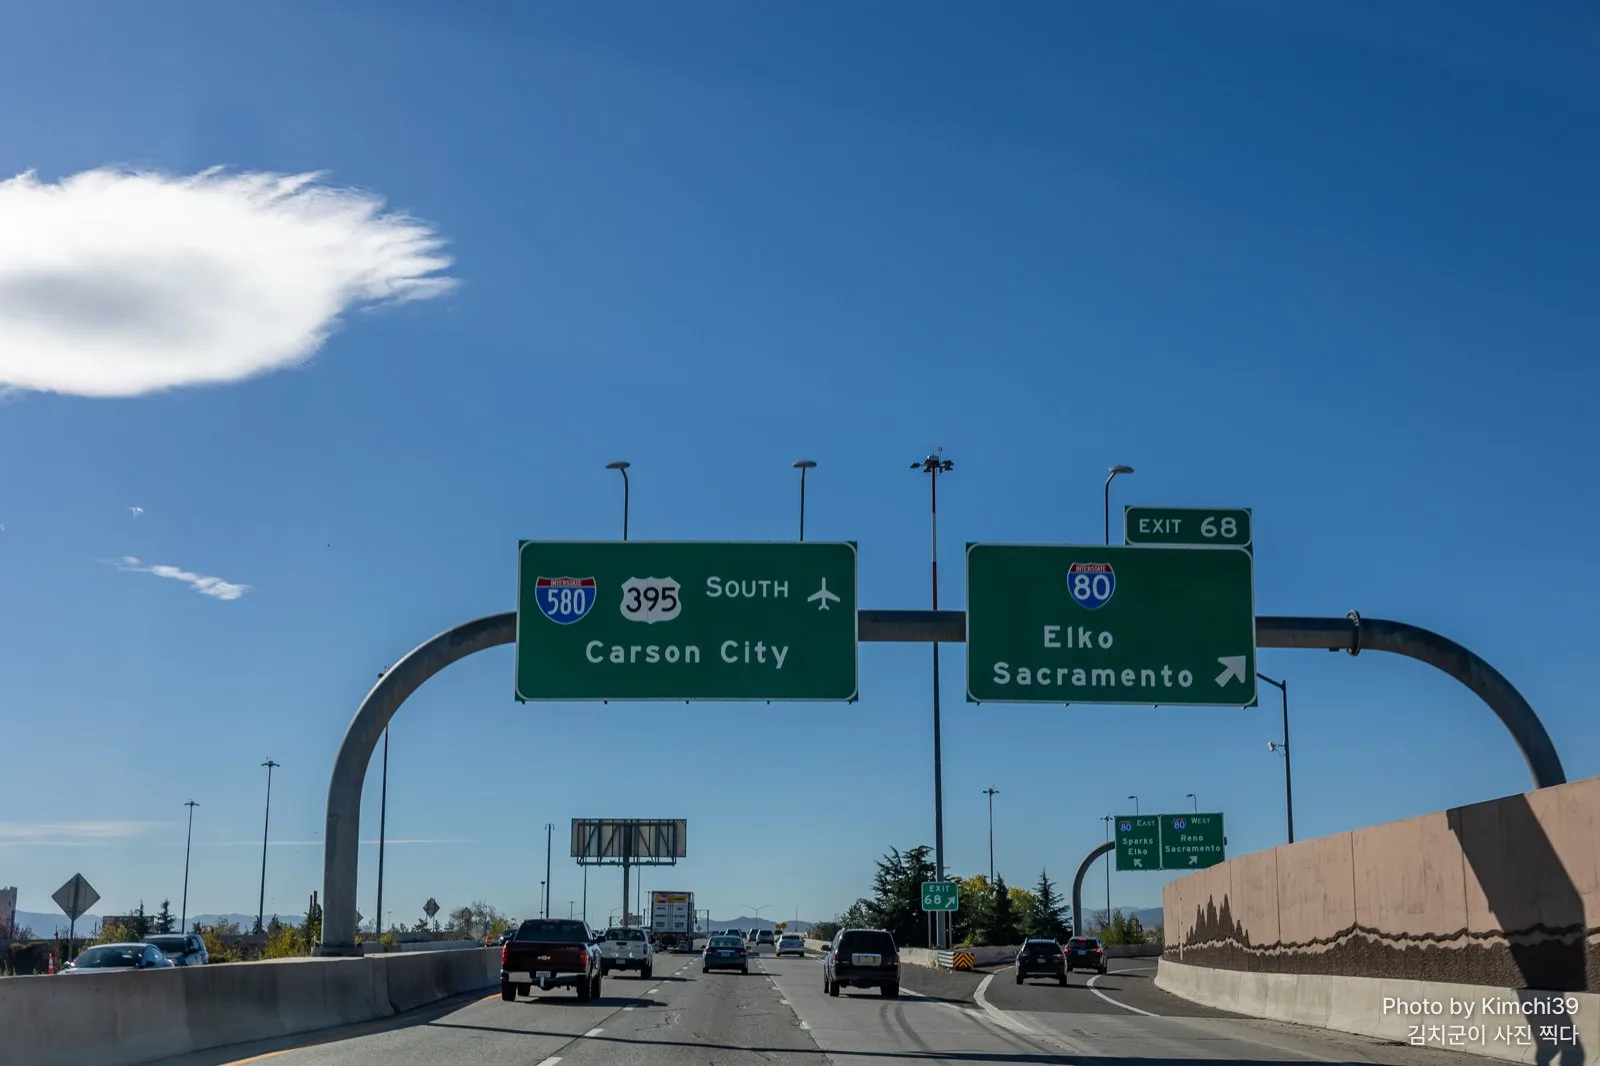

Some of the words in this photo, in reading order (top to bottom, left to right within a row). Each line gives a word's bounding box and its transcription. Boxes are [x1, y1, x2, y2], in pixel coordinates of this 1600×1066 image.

[1139, 518, 1182, 534] EXIT
[1200, 516, 1238, 538] 68
[706, 576, 789, 598] SOUTH
[1073, 574, 1110, 600] 80
[547, 588, 586, 615] 580
[625, 586, 677, 613] 395
[1043, 625, 1114, 649] Elko
[585, 640, 701, 663] Carson
[720, 640, 789, 669] City
[992, 661, 1193, 687] Sacramento
[1120, 823, 1132, 832] 80
[1136, 819, 1156, 827] EAST
[1174, 821, 1185, 829] 80
[1122, 837, 1154, 846] Sparks
[1164, 844, 1221, 853] Sacramento
[1180, 834, 1204, 842] Reno
[924, 894, 942, 905] 68
